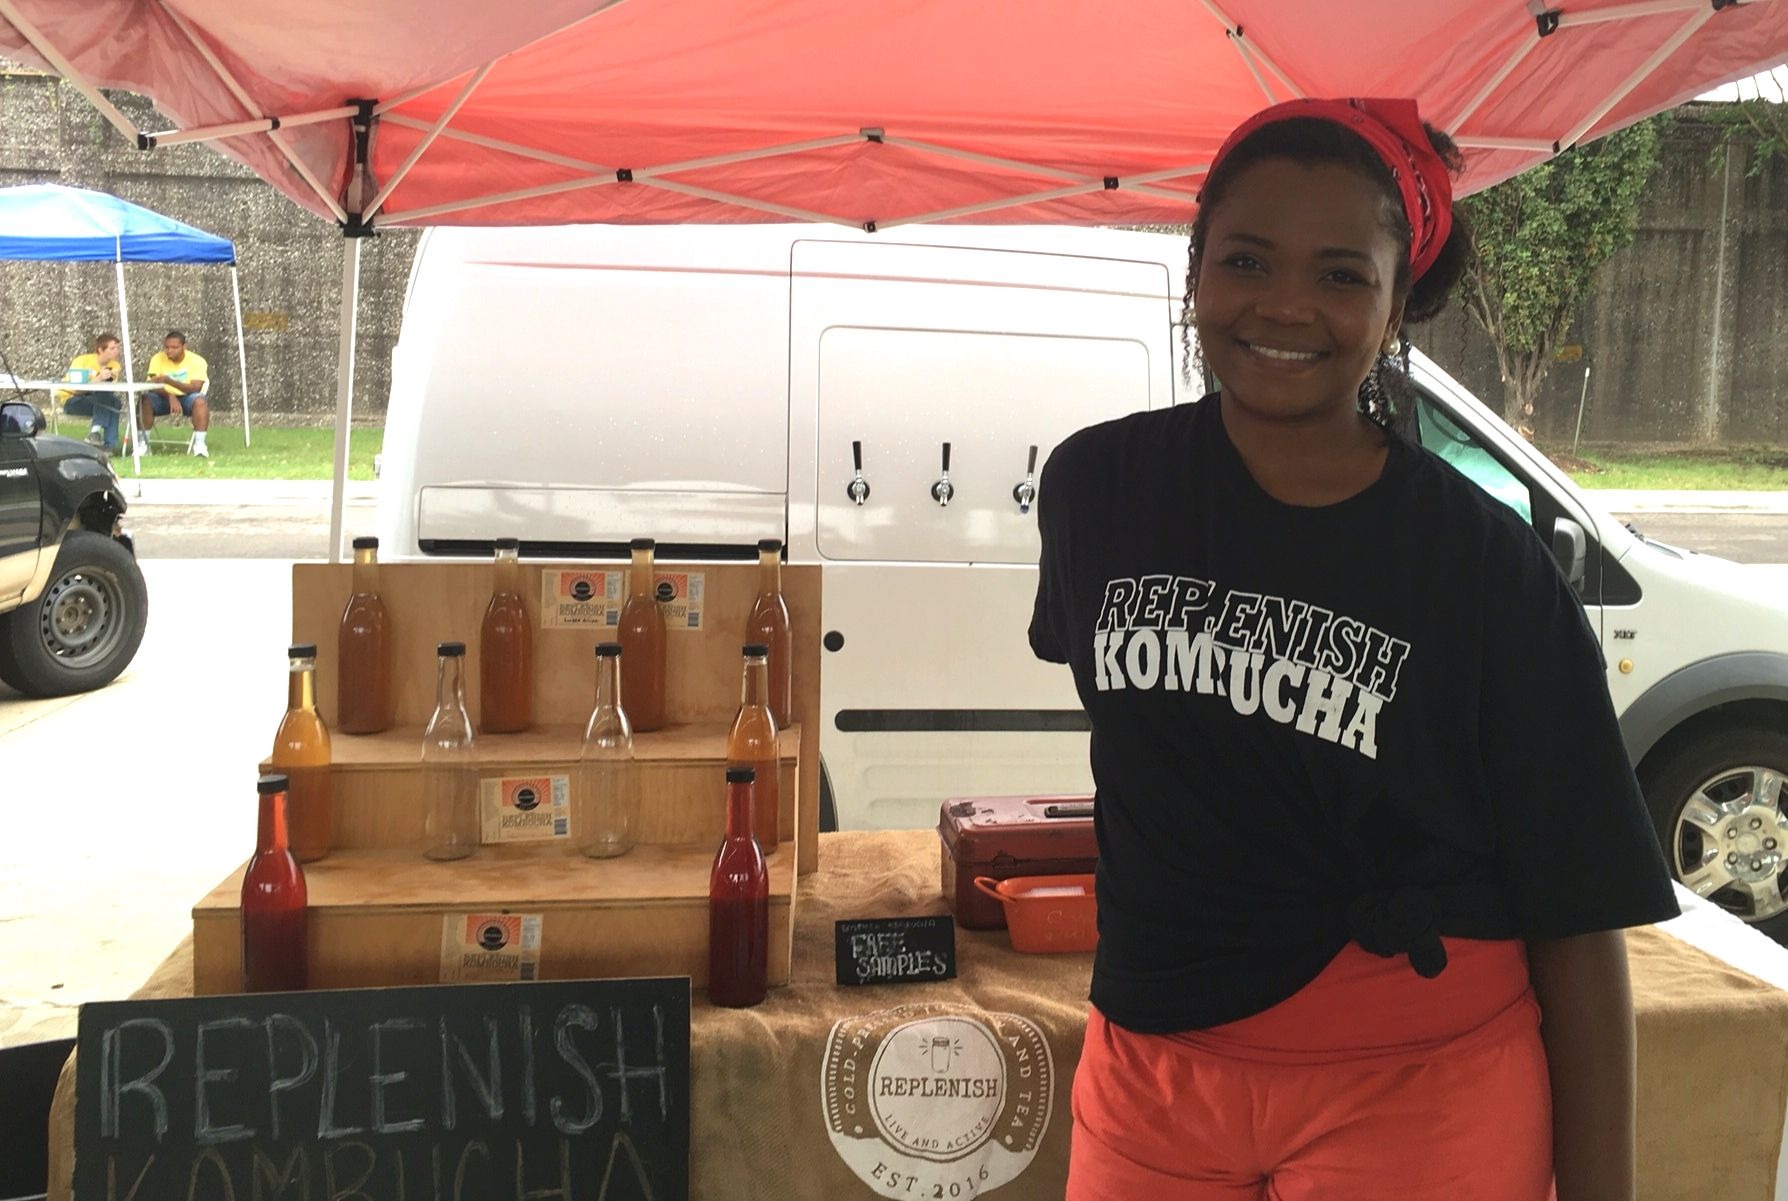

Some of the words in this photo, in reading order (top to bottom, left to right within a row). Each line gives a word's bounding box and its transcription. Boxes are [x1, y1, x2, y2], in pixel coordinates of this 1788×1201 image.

[856, 950, 947, 980] SAMPLES
[100, 1004, 667, 1144] REPLENISH
[1008, 1035, 1032, 1078] AND
[879, 1076, 998, 1098] REPLENISH
[1011, 1091, 1032, 1127] TEA
[885, 1114, 909, 1140] LIVE
[912, 1137, 939, 1149] AND
[947, 1116, 990, 1150] ACTIVE
